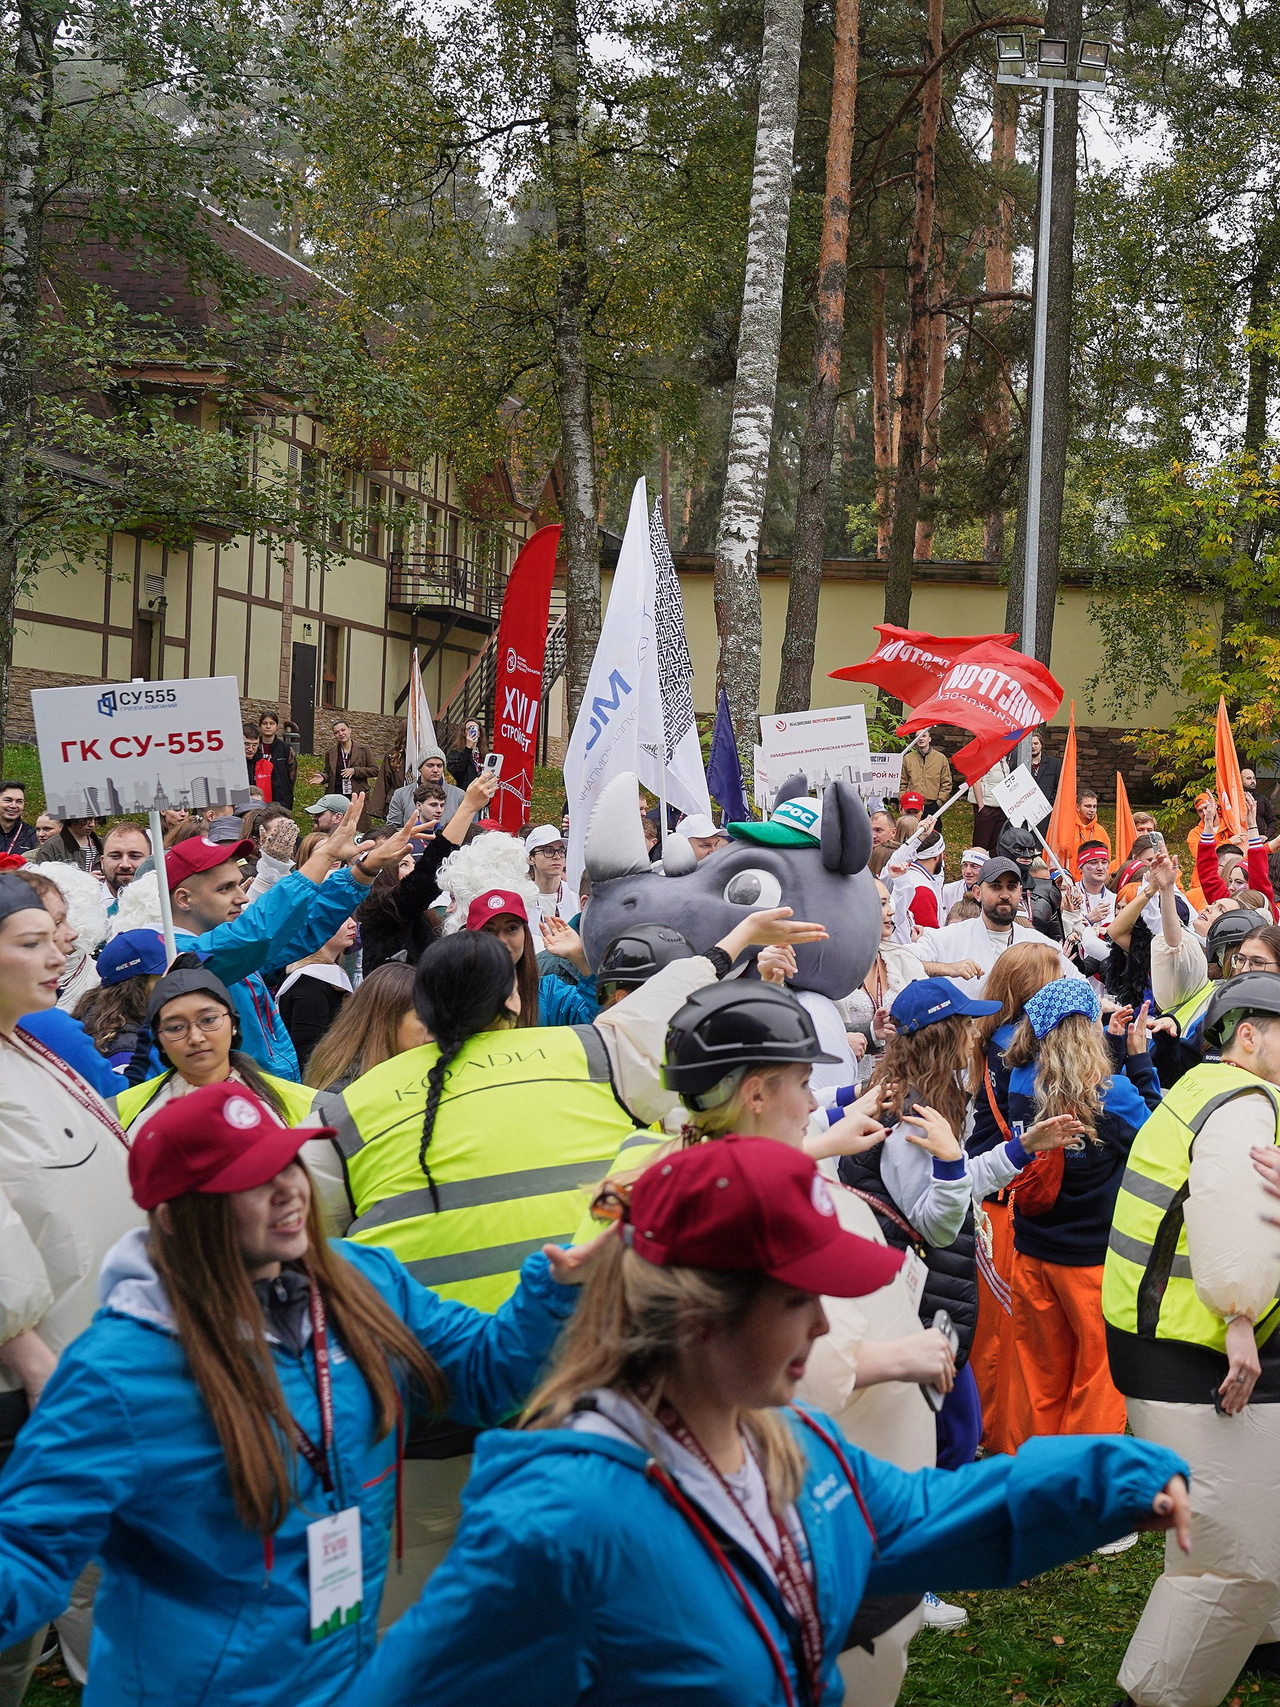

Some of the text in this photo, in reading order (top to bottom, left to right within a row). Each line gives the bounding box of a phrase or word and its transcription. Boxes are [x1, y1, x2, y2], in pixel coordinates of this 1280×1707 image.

[119, 689, 177, 705] СУ 555
[61, 730, 224, 763] ГК СУ-555
